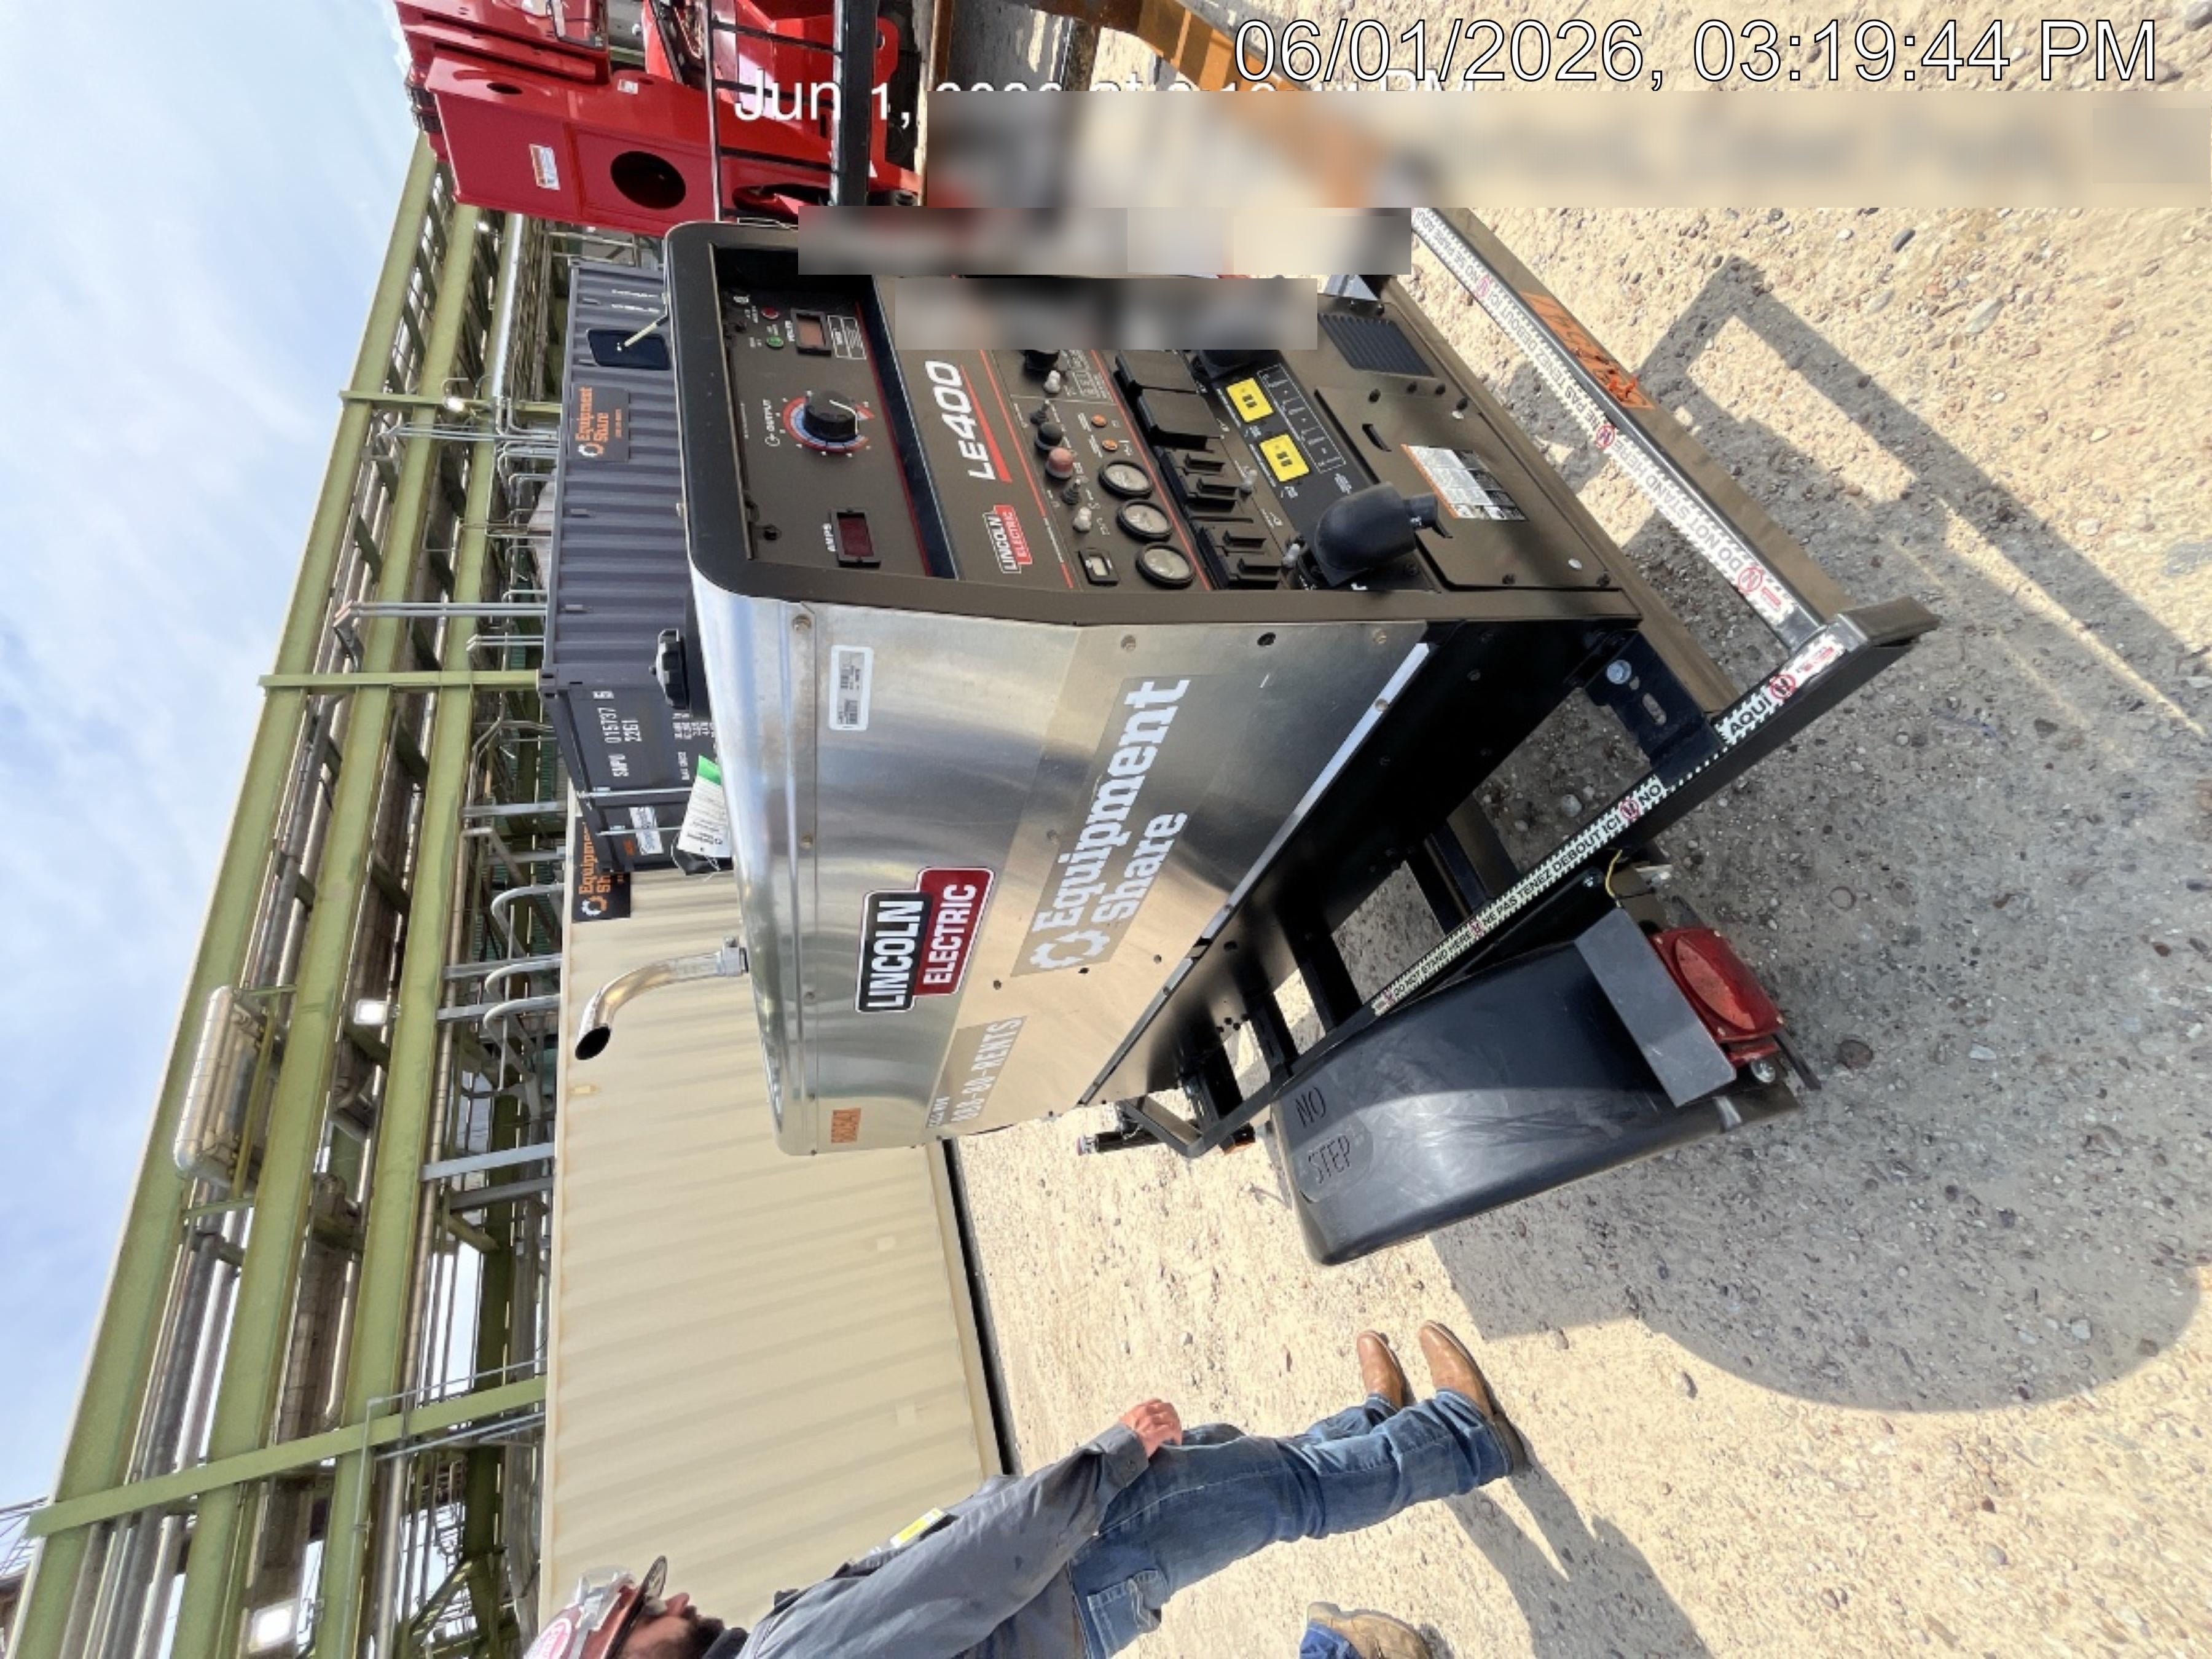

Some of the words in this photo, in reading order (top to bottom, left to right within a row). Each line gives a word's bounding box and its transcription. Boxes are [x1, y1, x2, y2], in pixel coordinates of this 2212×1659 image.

[1500, 306, 1539, 352] DEBOUT
[575, 386, 594, 441] Equipment
[925, 359, 996, 480] LE400
[1611, 440, 1648, 477] HERE
[1644, 473, 1691, 519] STAND
[985, 514, 1018, 571] LINCOLN
[1001, 510, 1028, 557] ELECTRIC
[1688, 516, 1721, 550] NOT
[1717, 544, 1744, 573] DO
[597, 707, 621, 743] 015737
[1031, 679, 1191, 932] Equipment
[1638, 783, 1663, 806] NO
[578, 822, 598, 895] Equipme
[1091, 812, 1188, 923] Share
[1496, 895, 1518, 915] PAS
[1515, 868, 1551, 900] TENEZ
[1551, 830, 1604, 873] DEBOUT
[1601, 814, 1623, 833] ICI
[866, 900, 924, 1008] LINCOLN
[923, 884, 977, 984] ELECTRIC
[1295, 1086, 1327, 1127] NO
[1308, 1135, 1350, 1185] STEP
